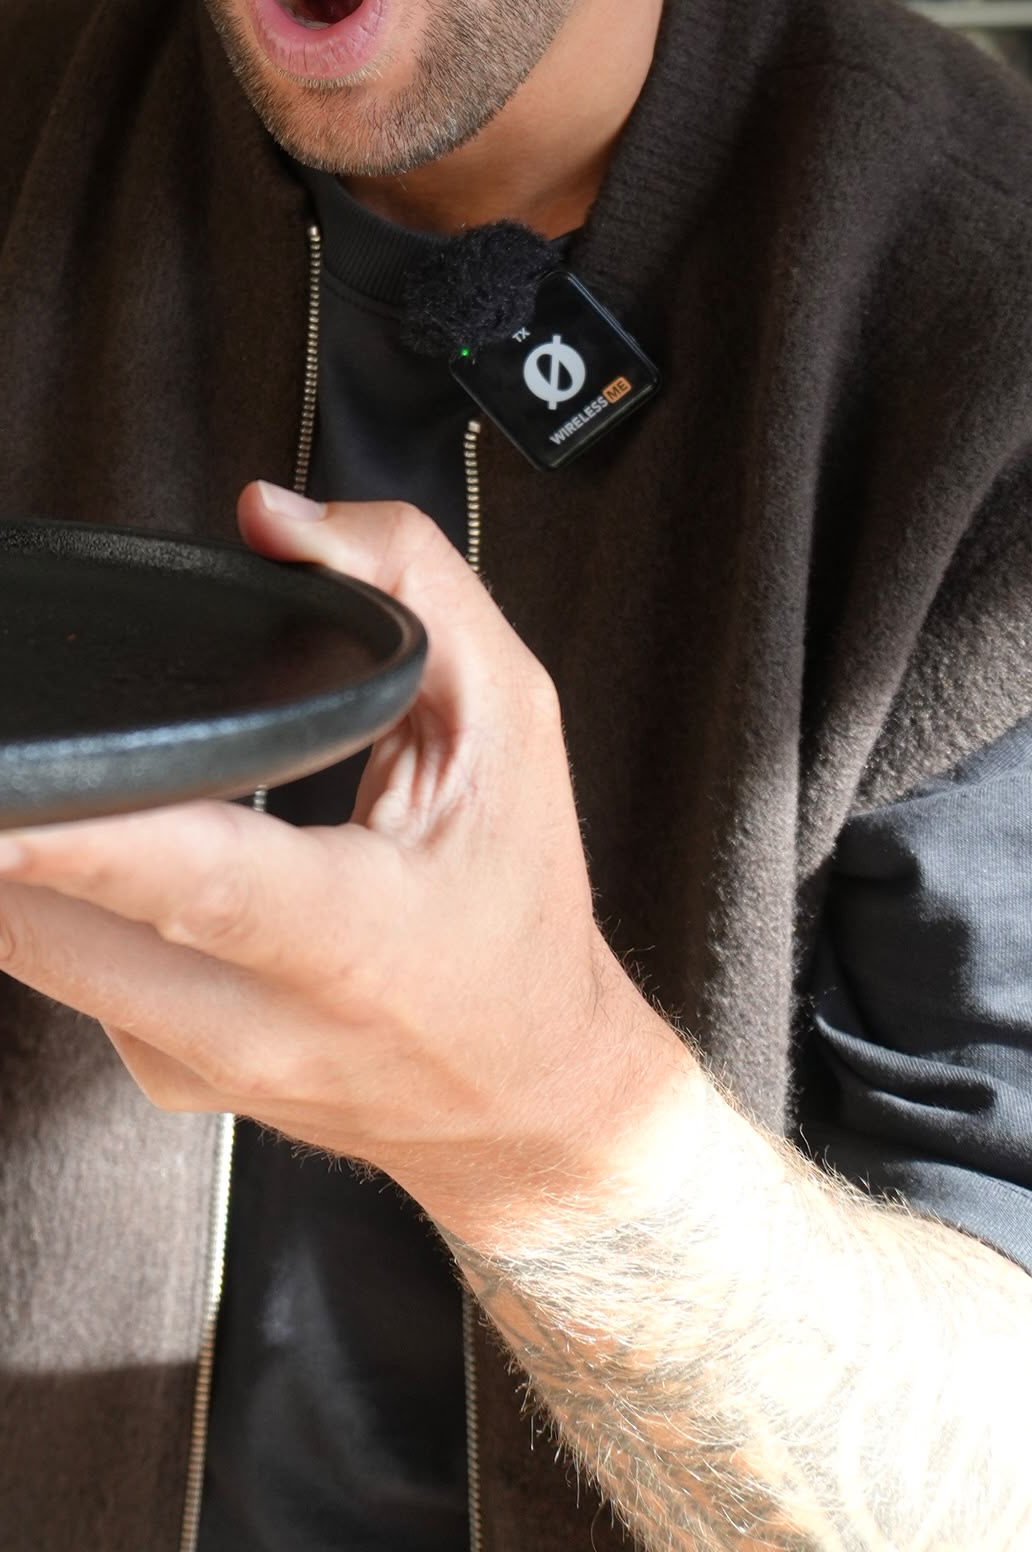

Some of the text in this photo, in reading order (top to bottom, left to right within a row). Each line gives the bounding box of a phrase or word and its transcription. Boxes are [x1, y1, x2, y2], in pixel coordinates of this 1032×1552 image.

[511, 327, 531, 343] TX
[550, 380, 629, 446] WIRELESS ME
